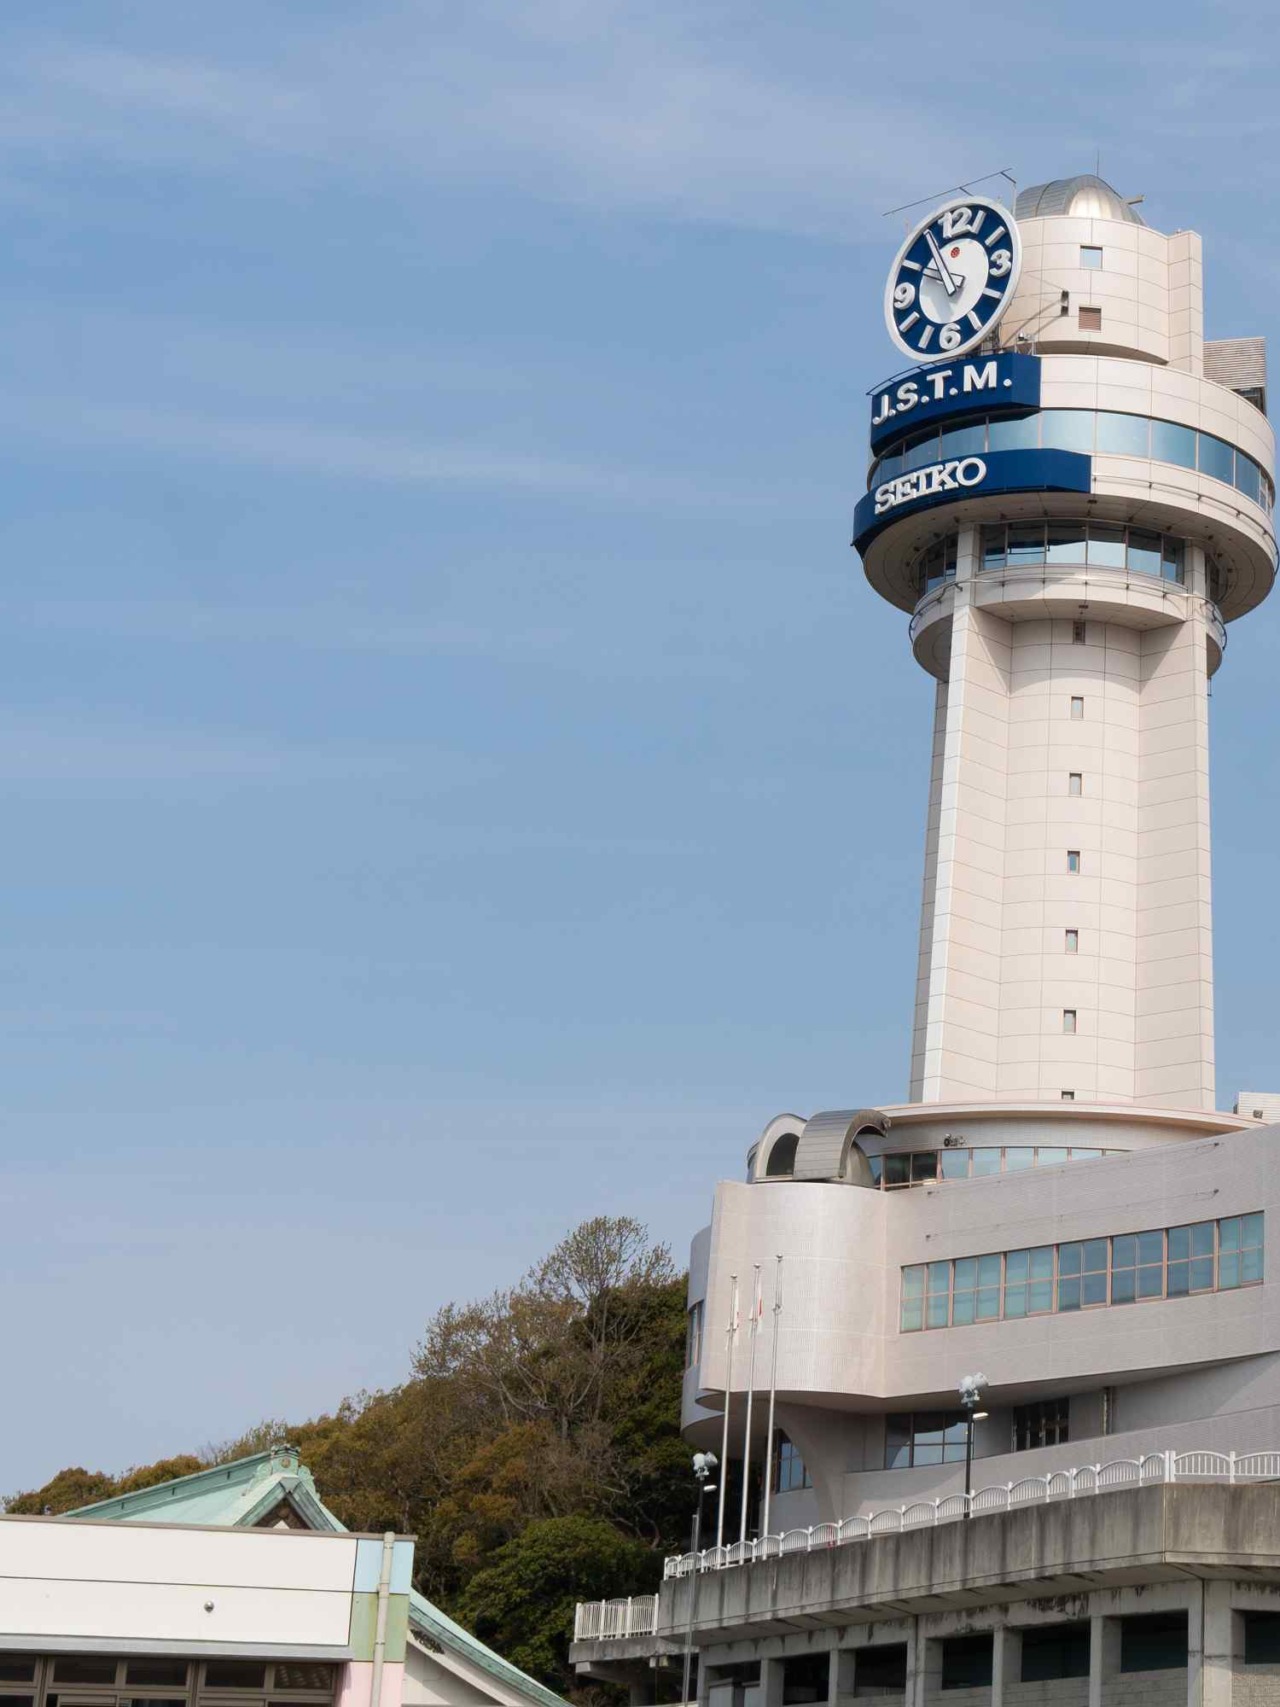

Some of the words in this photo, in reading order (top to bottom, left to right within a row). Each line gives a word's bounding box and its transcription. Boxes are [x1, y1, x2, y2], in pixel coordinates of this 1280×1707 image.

[938, 206, 972, 239] 12
[989, 249, 1012, 278] 3
[893, 281, 916, 309] 9
[938, 322, 961, 350] 6
[872, 360, 1012, 425] J.S.T.M.
[874, 457, 987, 515] SEIKO
